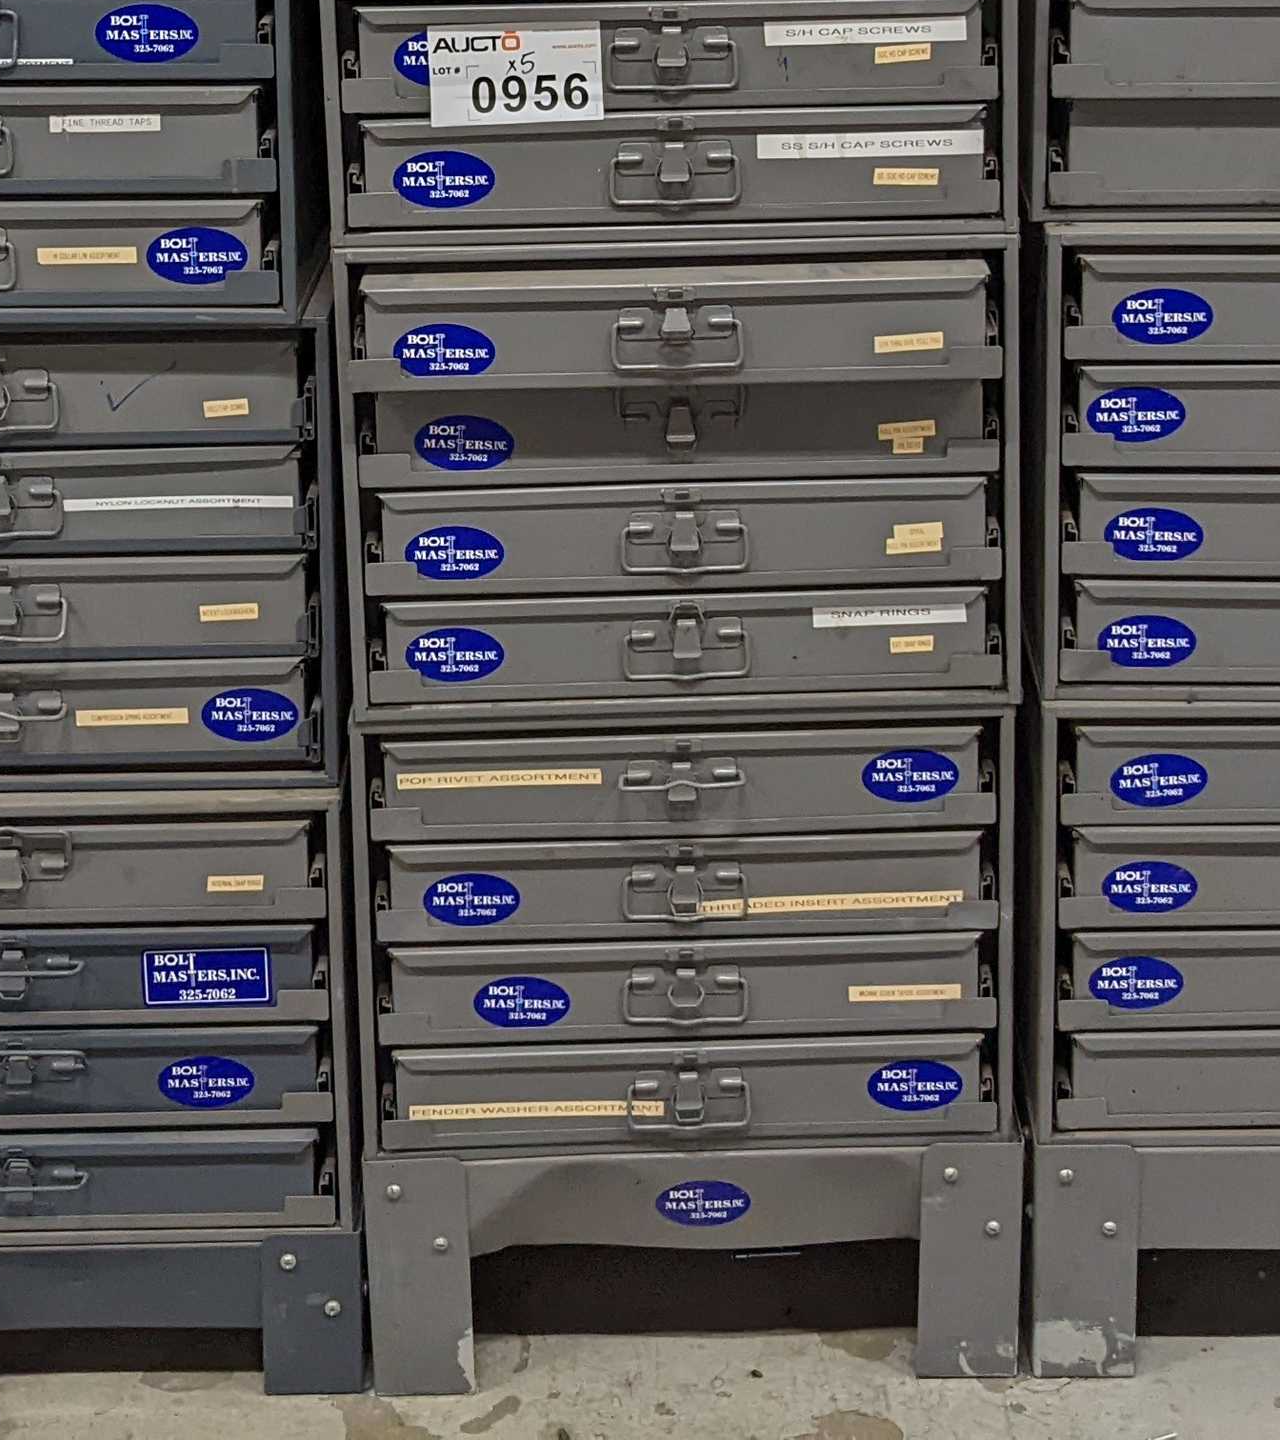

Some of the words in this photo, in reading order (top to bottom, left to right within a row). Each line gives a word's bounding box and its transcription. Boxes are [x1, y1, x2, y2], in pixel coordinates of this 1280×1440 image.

[786, 29, 813, 38] S/H
[818, 27, 853, 36] CAP
[857, 25, 932, 35] SCREWS
[432, 31, 520, 54] AUCTO
[433, 67, 452, 76] LOT
[471, 73, 590, 114] 0956
[61, 119, 86, 128] FINE
[90, 118, 124, 127] THREAD
[129, 117, 152, 127] TAPS
[781, 142, 803, 150] SS
[808, 141, 835, 150] S/H
[840, 140, 876, 150] CAP
[880, 139, 953, 149] SCREWS
[95, 499, 131, 507] NYLON
[133, 498, 185, 506] LOCKNUT
[188, 496, 262, 505] ASSORTMENT
[831, 609, 874, 619] SNAP
[880, 608, 931, 617] RINGS
[399, 777, 432, 785] POP
[437, 775, 483, 784] RIVET
[489, 772, 599, 783] ASSORTMENT
[702, 901, 785, 913] THREADED
[790, 898, 843, 907] INSERT
[851, 894, 960, 905] ASSORTMENT
[154, 953, 197, 967] BOLT
[179, 988, 236, 1002] 325-7062
[412, 1108, 477, 1117] FENDER
[483, 1106, 549, 1115] WASHER
[554, 1103, 661, 1114] ASSORTMENT
